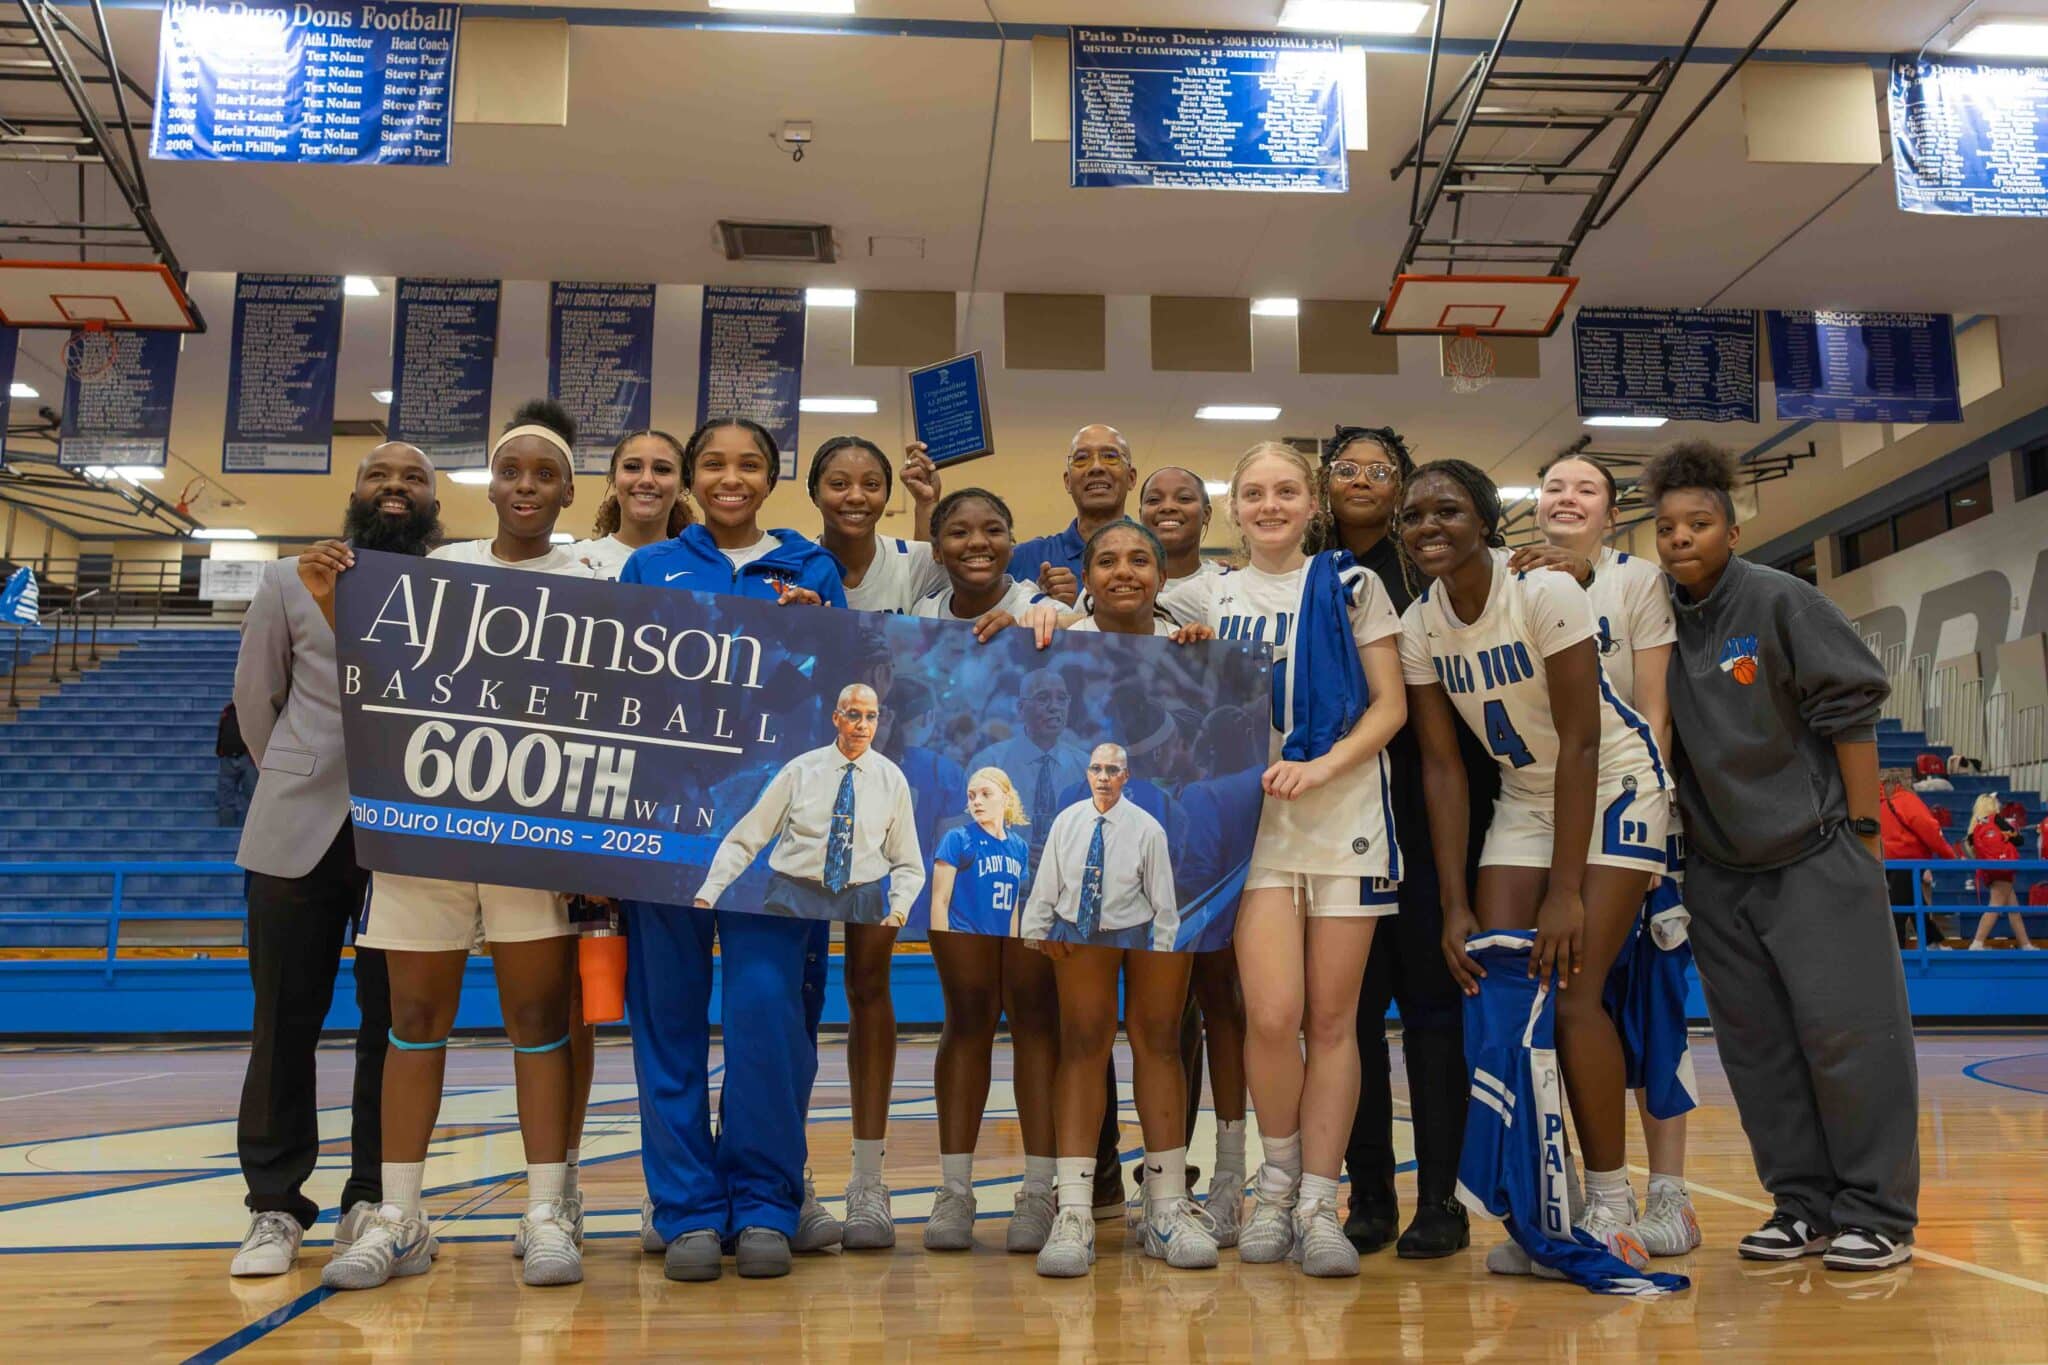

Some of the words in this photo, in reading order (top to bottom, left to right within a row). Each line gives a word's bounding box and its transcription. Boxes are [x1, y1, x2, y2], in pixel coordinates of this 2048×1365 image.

[292, 3, 352, 27] Dons
[360, 6, 452, 30] Football
[304, 33, 328, 47] Athl.
[330, 34, 373, 49] Director
[391, 37, 416, 50] Head
[419, 38, 449, 50] Coach
[1079, 31, 1116, 41] Palo
[1123, 32, 1166, 43] Duro
[1173, 34, 1215, 45] Dons
[1222, 36, 1248, 47] 2004
[1251, 36, 1309, 49] FOOTBALL
[1312, 39, 1334, 49] 3-4A
[306, 50, 328, 62] Tex
[330, 51, 364, 63] Nolan
[1082, 44, 1133, 54] DISTRICT
[1136, 46, 1200, 57] CHAMPIONS
[1211, 50, 1277, 59] BI-DISTRICT
[386, 53, 417, 64] Steve
[420, 54, 446, 65] Parr
[305, 65, 326, 77] Tex
[328, 66, 363, 78] Nolan
[385, 69, 416, 80] Steve
[419, 69, 444, 80] Parr
[1185, 66, 1227, 77] VARSITY
[304, 82, 325, 93] Tex
[327, 82, 362, 94] Nolan
[384, 84, 416, 95] Steve
[419, 85, 443, 96] Parr
[215, 94, 248, 105] Mark
[303, 97, 324, 108] Tex
[326, 98, 361, 110] Nolan
[382, 99, 415, 111] Steve
[418, 100, 442, 111] Parr
[214, 110, 247, 121] Mark
[301, 112, 323, 124] Tex
[325, 113, 360, 125] Nolan
[381, 114, 414, 126] Steve
[416, 115, 442, 126] Parr
[213, 125, 244, 136] Kevin
[246, 125, 288, 140] Phillips
[300, 128, 321, 139] Tex
[323, 128, 359, 140] Nolan
[380, 130, 412, 142] Steve
[415, 130, 441, 141] Parr
[212, 140, 243, 152] Kevin
[245, 141, 287, 155] Phillips
[299, 143, 320, 155] Tex
[322, 144, 358, 156] Nolan
[379, 146, 411, 157] Steve
[414, 146, 441, 157] Parr
[1186, 160, 1232, 168] COACHES
[258, 285, 294, 299] DISTRICT
[294, 286, 340, 300] CHAMPIONS
[419, 287, 453, 300] DISTRICT
[453, 288, 497, 301] CHAMPIONS
[574, 293, 608, 306] DISTRICT
[608, 294, 652, 307] CHAMPIONS
[724, 296, 759, 310] DISTRICT
[758, 299, 801, 312] CHAMPIONS
[360, 574, 450, 671] AJ
[452, 583, 764, 688] Johnson
[1477, 641, 1534, 690] DURO
[344, 665, 777, 745] BASKETBALL
[1483, 699, 1536, 769] 4
[404, 720, 637, 820] 600TH
[633, 799, 715, 829] WIN
[383, 807, 438, 831] Duro
[445, 813, 505, 844] Lady
[511, 820, 574, 847] Dons
[601, 829, 663, 855] 2025
[1623, 820, 1648, 843] PD
[979, 855, 1003, 877] LADY
[993, 881, 1013, 910] 20
[1543, 1112, 1563, 1233] PALO
